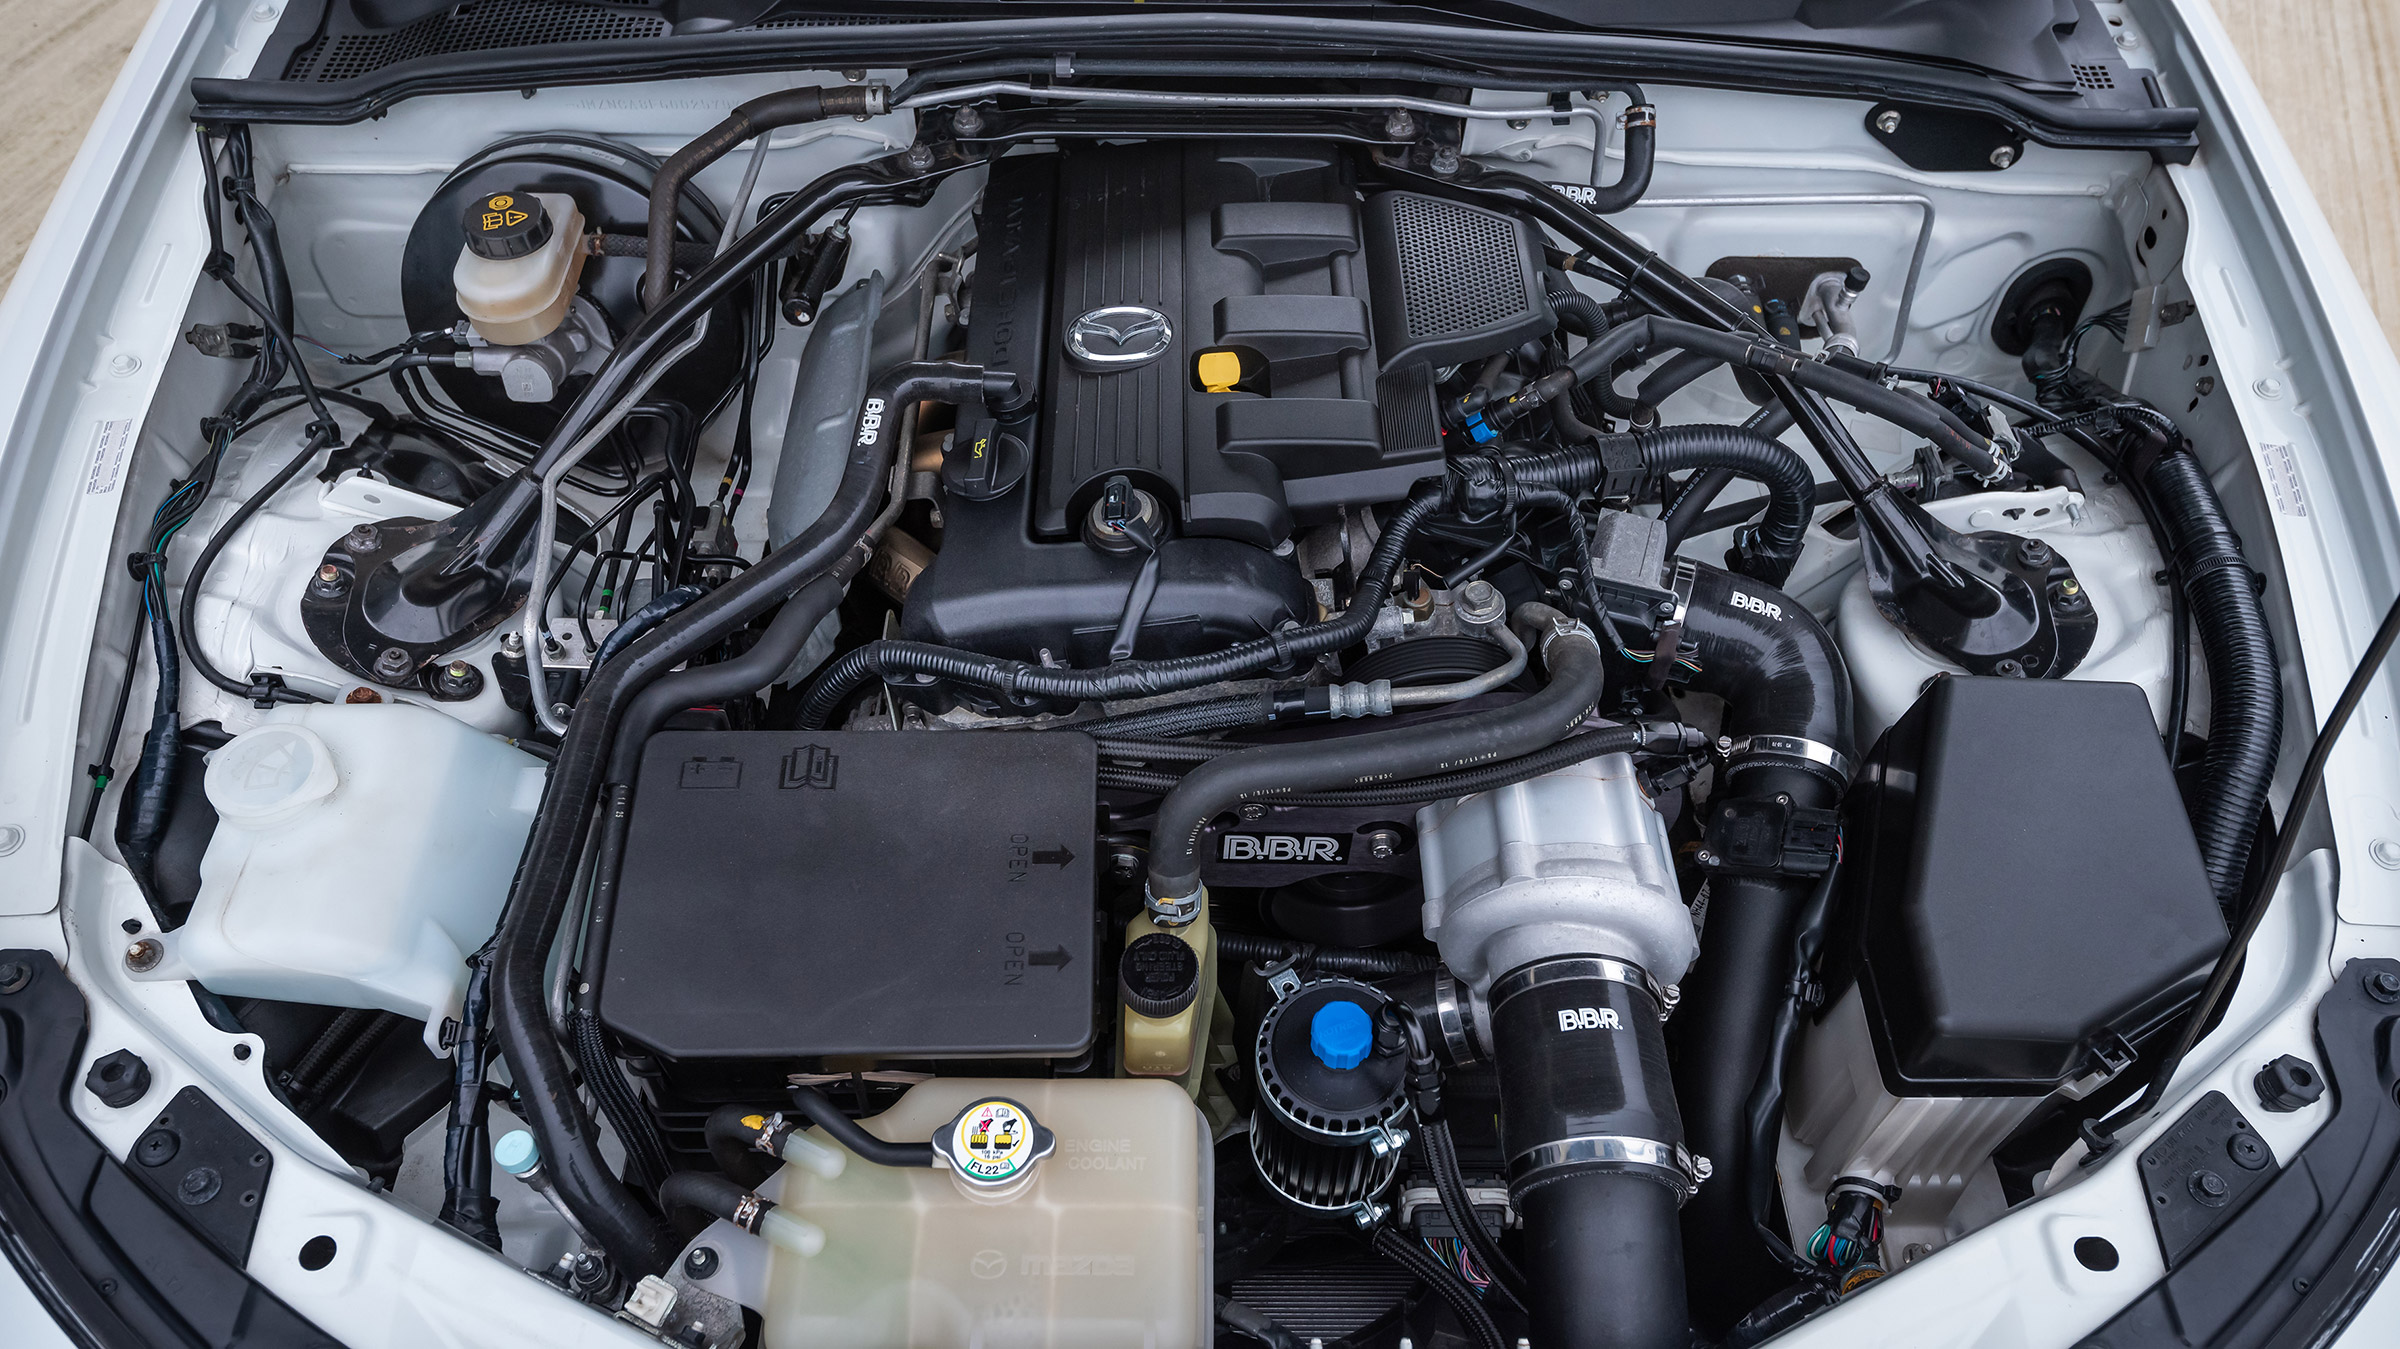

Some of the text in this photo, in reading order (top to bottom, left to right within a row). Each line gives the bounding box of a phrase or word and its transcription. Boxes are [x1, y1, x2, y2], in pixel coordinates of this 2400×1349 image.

[1551, 184, 1597, 205] B.R.
[857, 398, 885, 447] B.B.R.
[1730, 590, 1783, 622] B.B.R.
[1008, 833, 1029, 882] OPEN
[1223, 834, 1343, 862] B.B.R.
[1003, 932, 1025, 986] OPEN
[1133, 950, 1185, 961] FLUID ONLY
[1135, 961, 1184, 972] STEERING
[1557, 1007, 1624, 1032] B.B.R.
[1064, 1139, 1131, 1153] ENGINE
[970, 1161, 999, 1175] FL22
[1068, 1157, 1146, 1171] COOLANT
